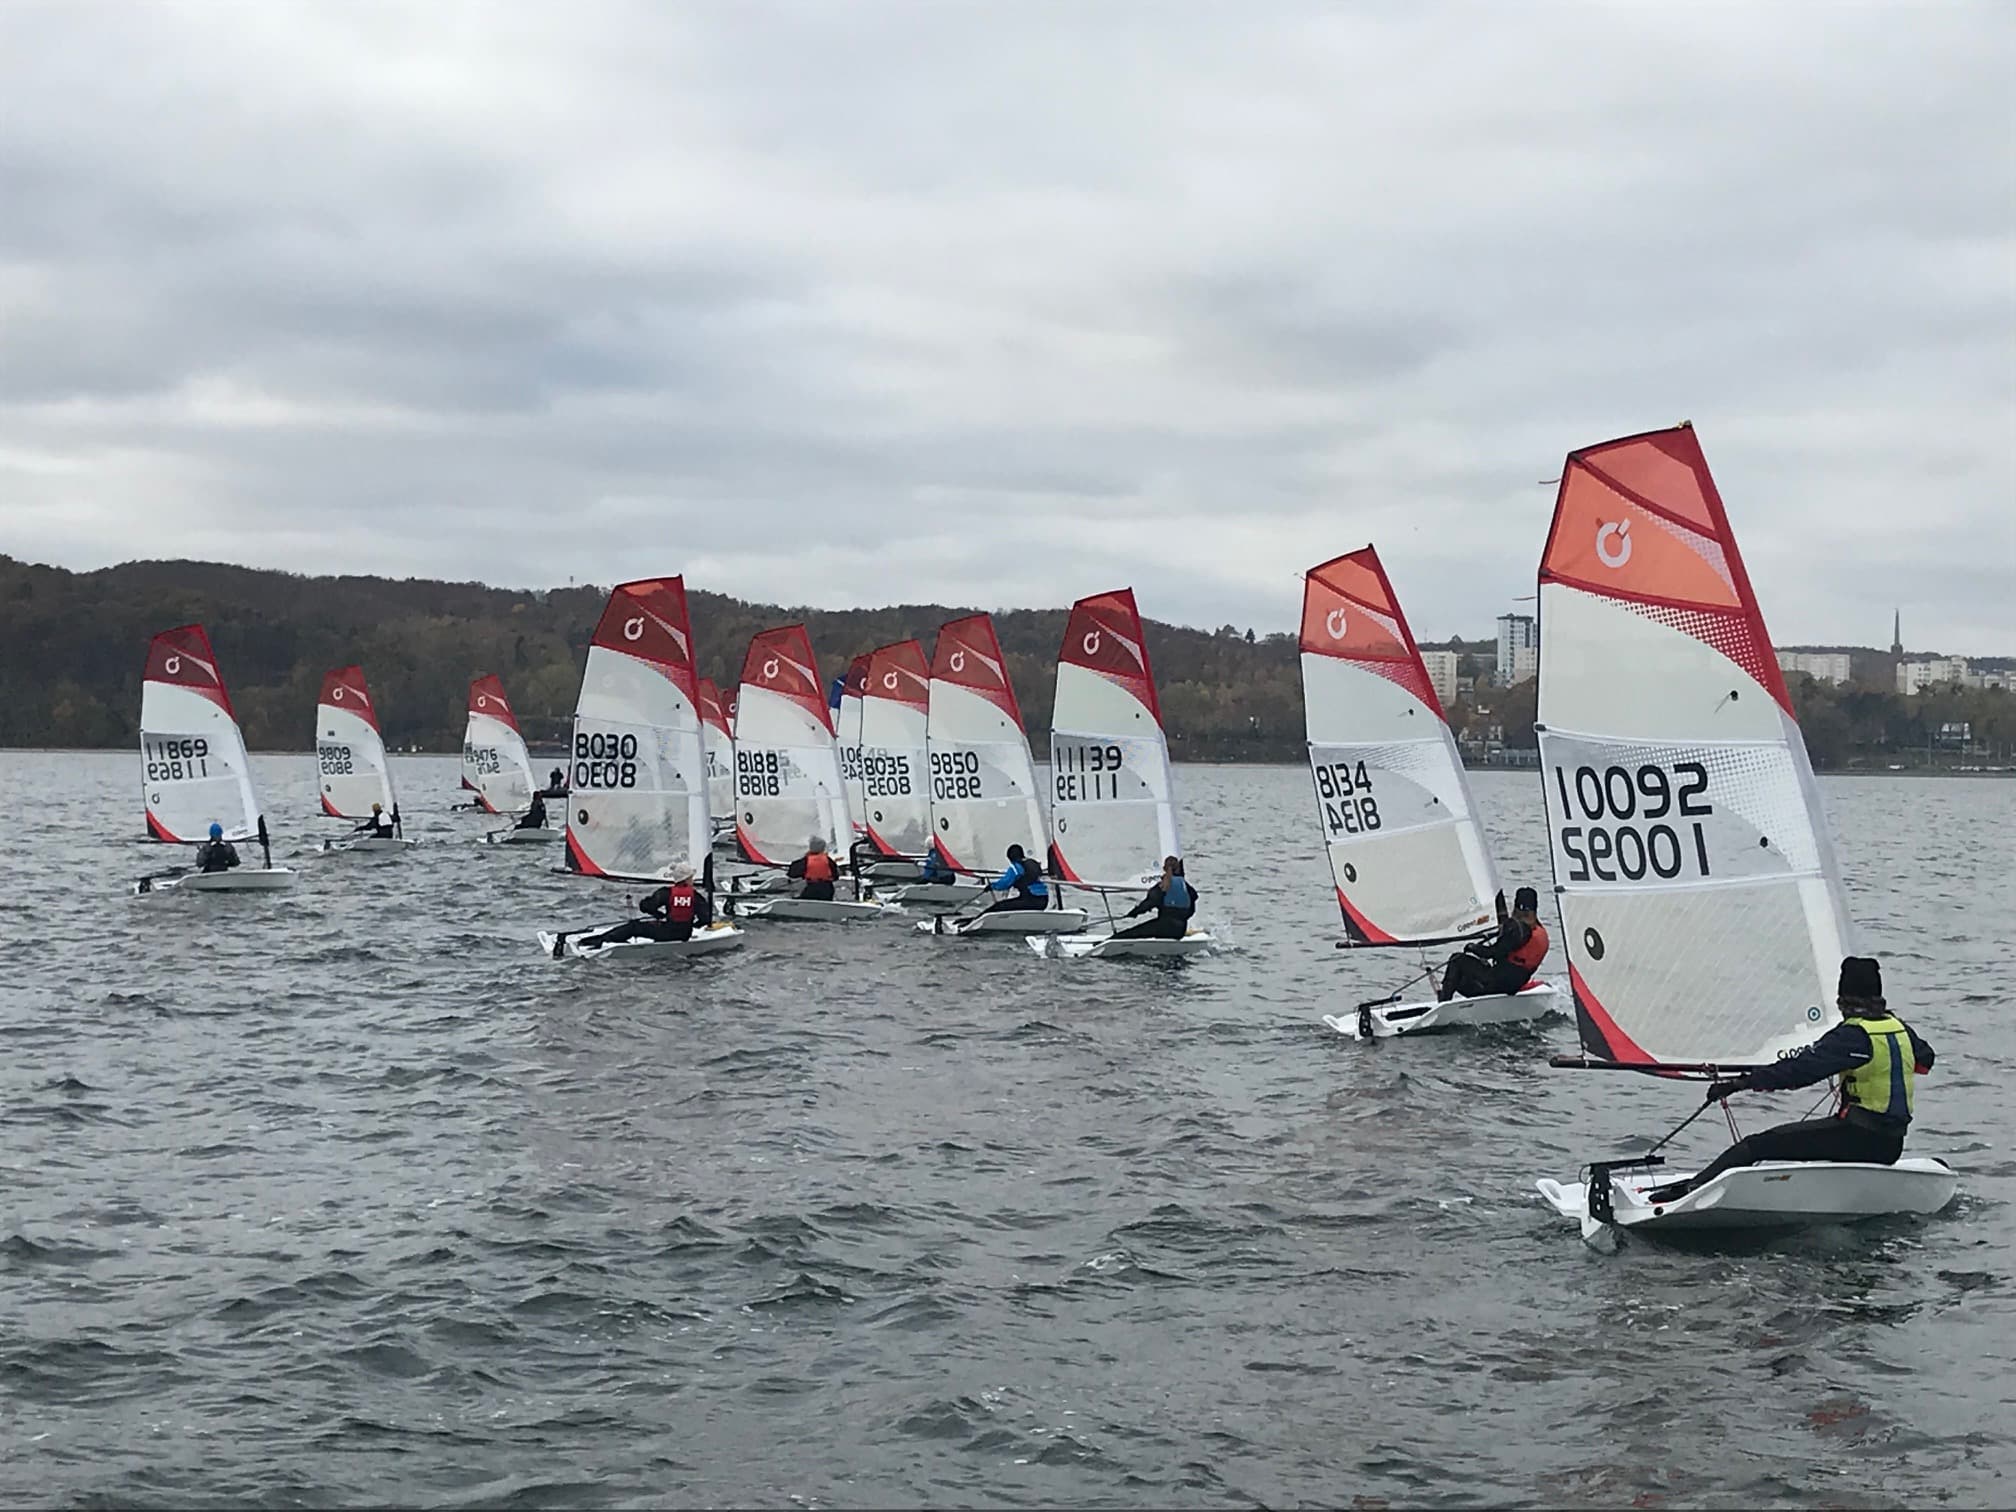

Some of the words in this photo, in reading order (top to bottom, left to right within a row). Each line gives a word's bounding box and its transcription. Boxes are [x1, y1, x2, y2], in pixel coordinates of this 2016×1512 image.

[147, 739, 208, 761] 11869
[319, 746, 351, 760] 9809
[576, 733, 637, 760] 8030
[738, 751, 779, 774] 8188
[864, 756, 909, 776] 8035
[931, 751, 979, 775] 9850
[1057, 746, 1122, 772] 11139
[1316, 760, 1372, 798] 8134
[1555, 762, 1712, 820] 10092
[674, 896, 691, 907] HH
